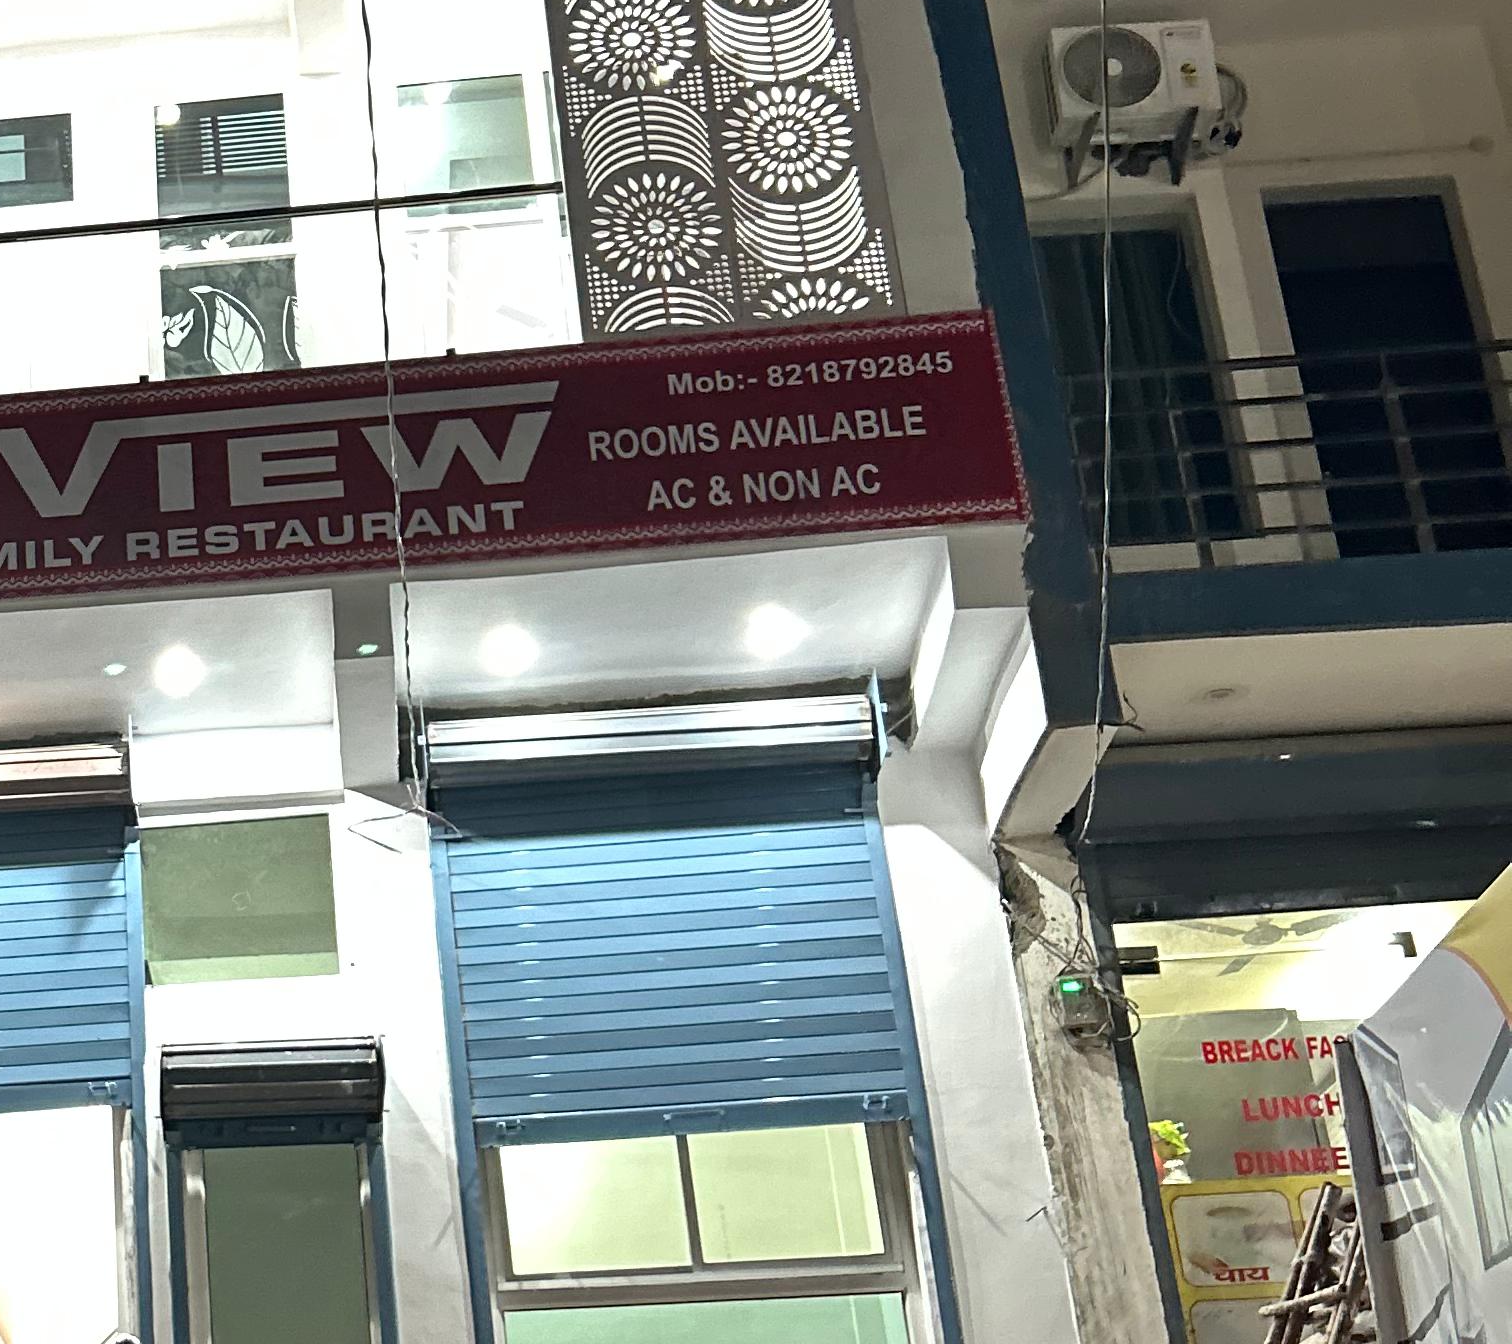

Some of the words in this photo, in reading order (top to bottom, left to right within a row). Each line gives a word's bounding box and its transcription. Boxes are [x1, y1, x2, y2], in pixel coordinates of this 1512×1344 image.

[667, 370, 758, 395] Mob:-
[766, 351, 953, 388] 8218792845
[588, 421, 720, 461] ROOMS
[730, 405, 927, 450] AVAILABLE
[647, 478, 697, 511] AC
[708, 475, 733, 507] &
[742, 468, 821, 504] NON
[832, 463, 881, 497] AC
[125, 500, 525, 562] RESTAURANT
[1201, 1037, 1300, 1065] BREACK
[1241, 1092, 1341, 1122] LUNCH
